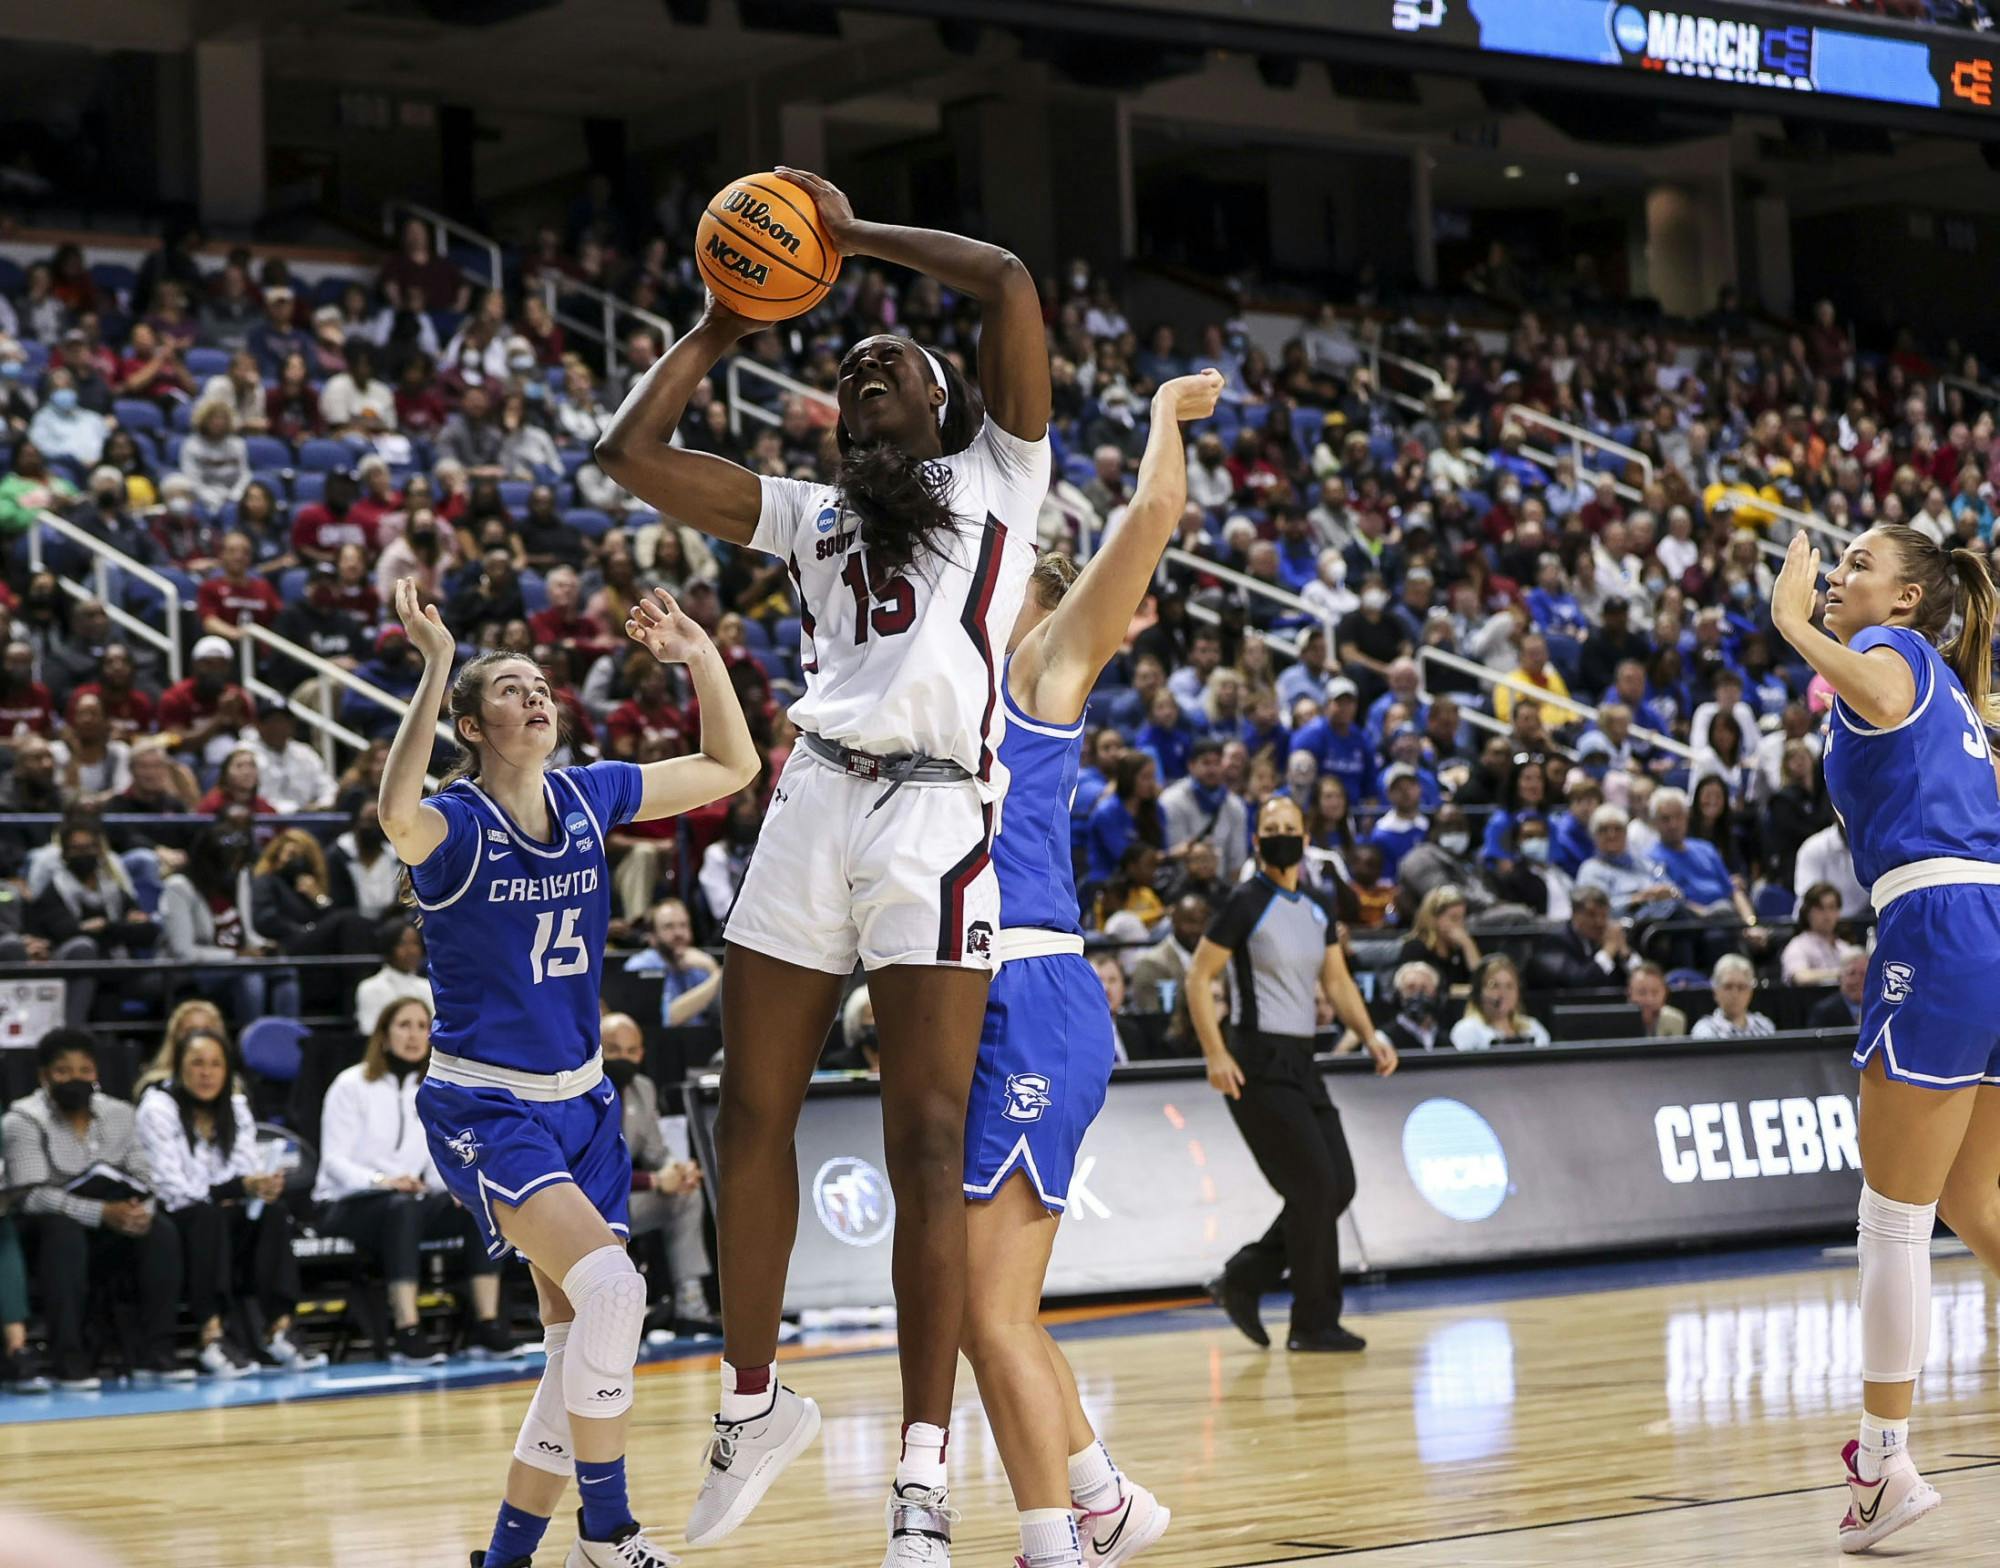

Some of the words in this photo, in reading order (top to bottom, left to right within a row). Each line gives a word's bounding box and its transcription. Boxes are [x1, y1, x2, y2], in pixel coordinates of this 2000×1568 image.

[1647, 9, 1760, 71] MARCH
[720, 188, 801, 256] Wilson
[705, 233, 770, 287] NCAA
[818, 514, 835, 528] NCAA
[841, 551, 917, 646] 15
[530, 907, 589, 985] 15
[1654, 1094, 1863, 1183] CELEBR
